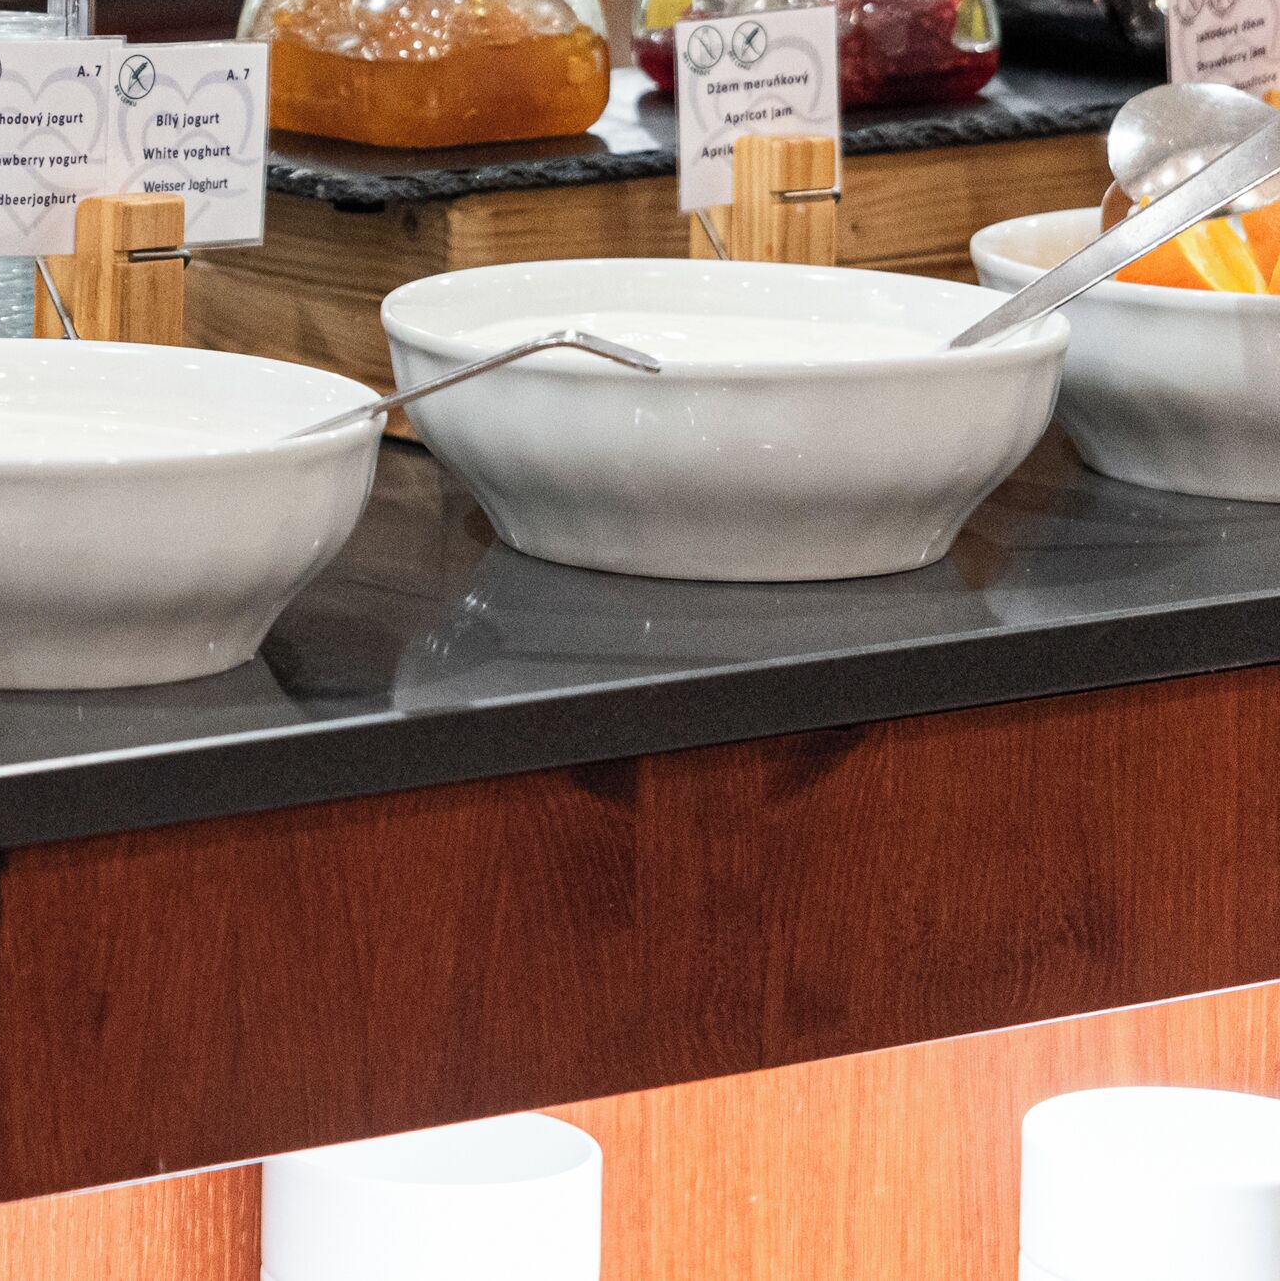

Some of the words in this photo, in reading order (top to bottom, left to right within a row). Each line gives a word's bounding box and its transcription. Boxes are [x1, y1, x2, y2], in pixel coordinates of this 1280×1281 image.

[76, 65, 91, 78] A.
[95, 65, 102, 77] 7
[226, 69, 240, 81] A.
[243, 68, 251, 80] 7
[706, 80, 739, 95] Džem
[46, 112, 84, 127] jogurt
[156, 112, 179, 128] Bílý
[181, 112, 220, 128] jogurt
[723, 108, 767, 126] Apricot
[770, 106, 793, 122] jam
[143, 146, 179, 161] White
[183, 144, 231, 160] yoghurt
[701, 145, 734, 160] Aprik
[48, 153, 88, 168] yogurt
[143, 179, 186, 194] Weisser
